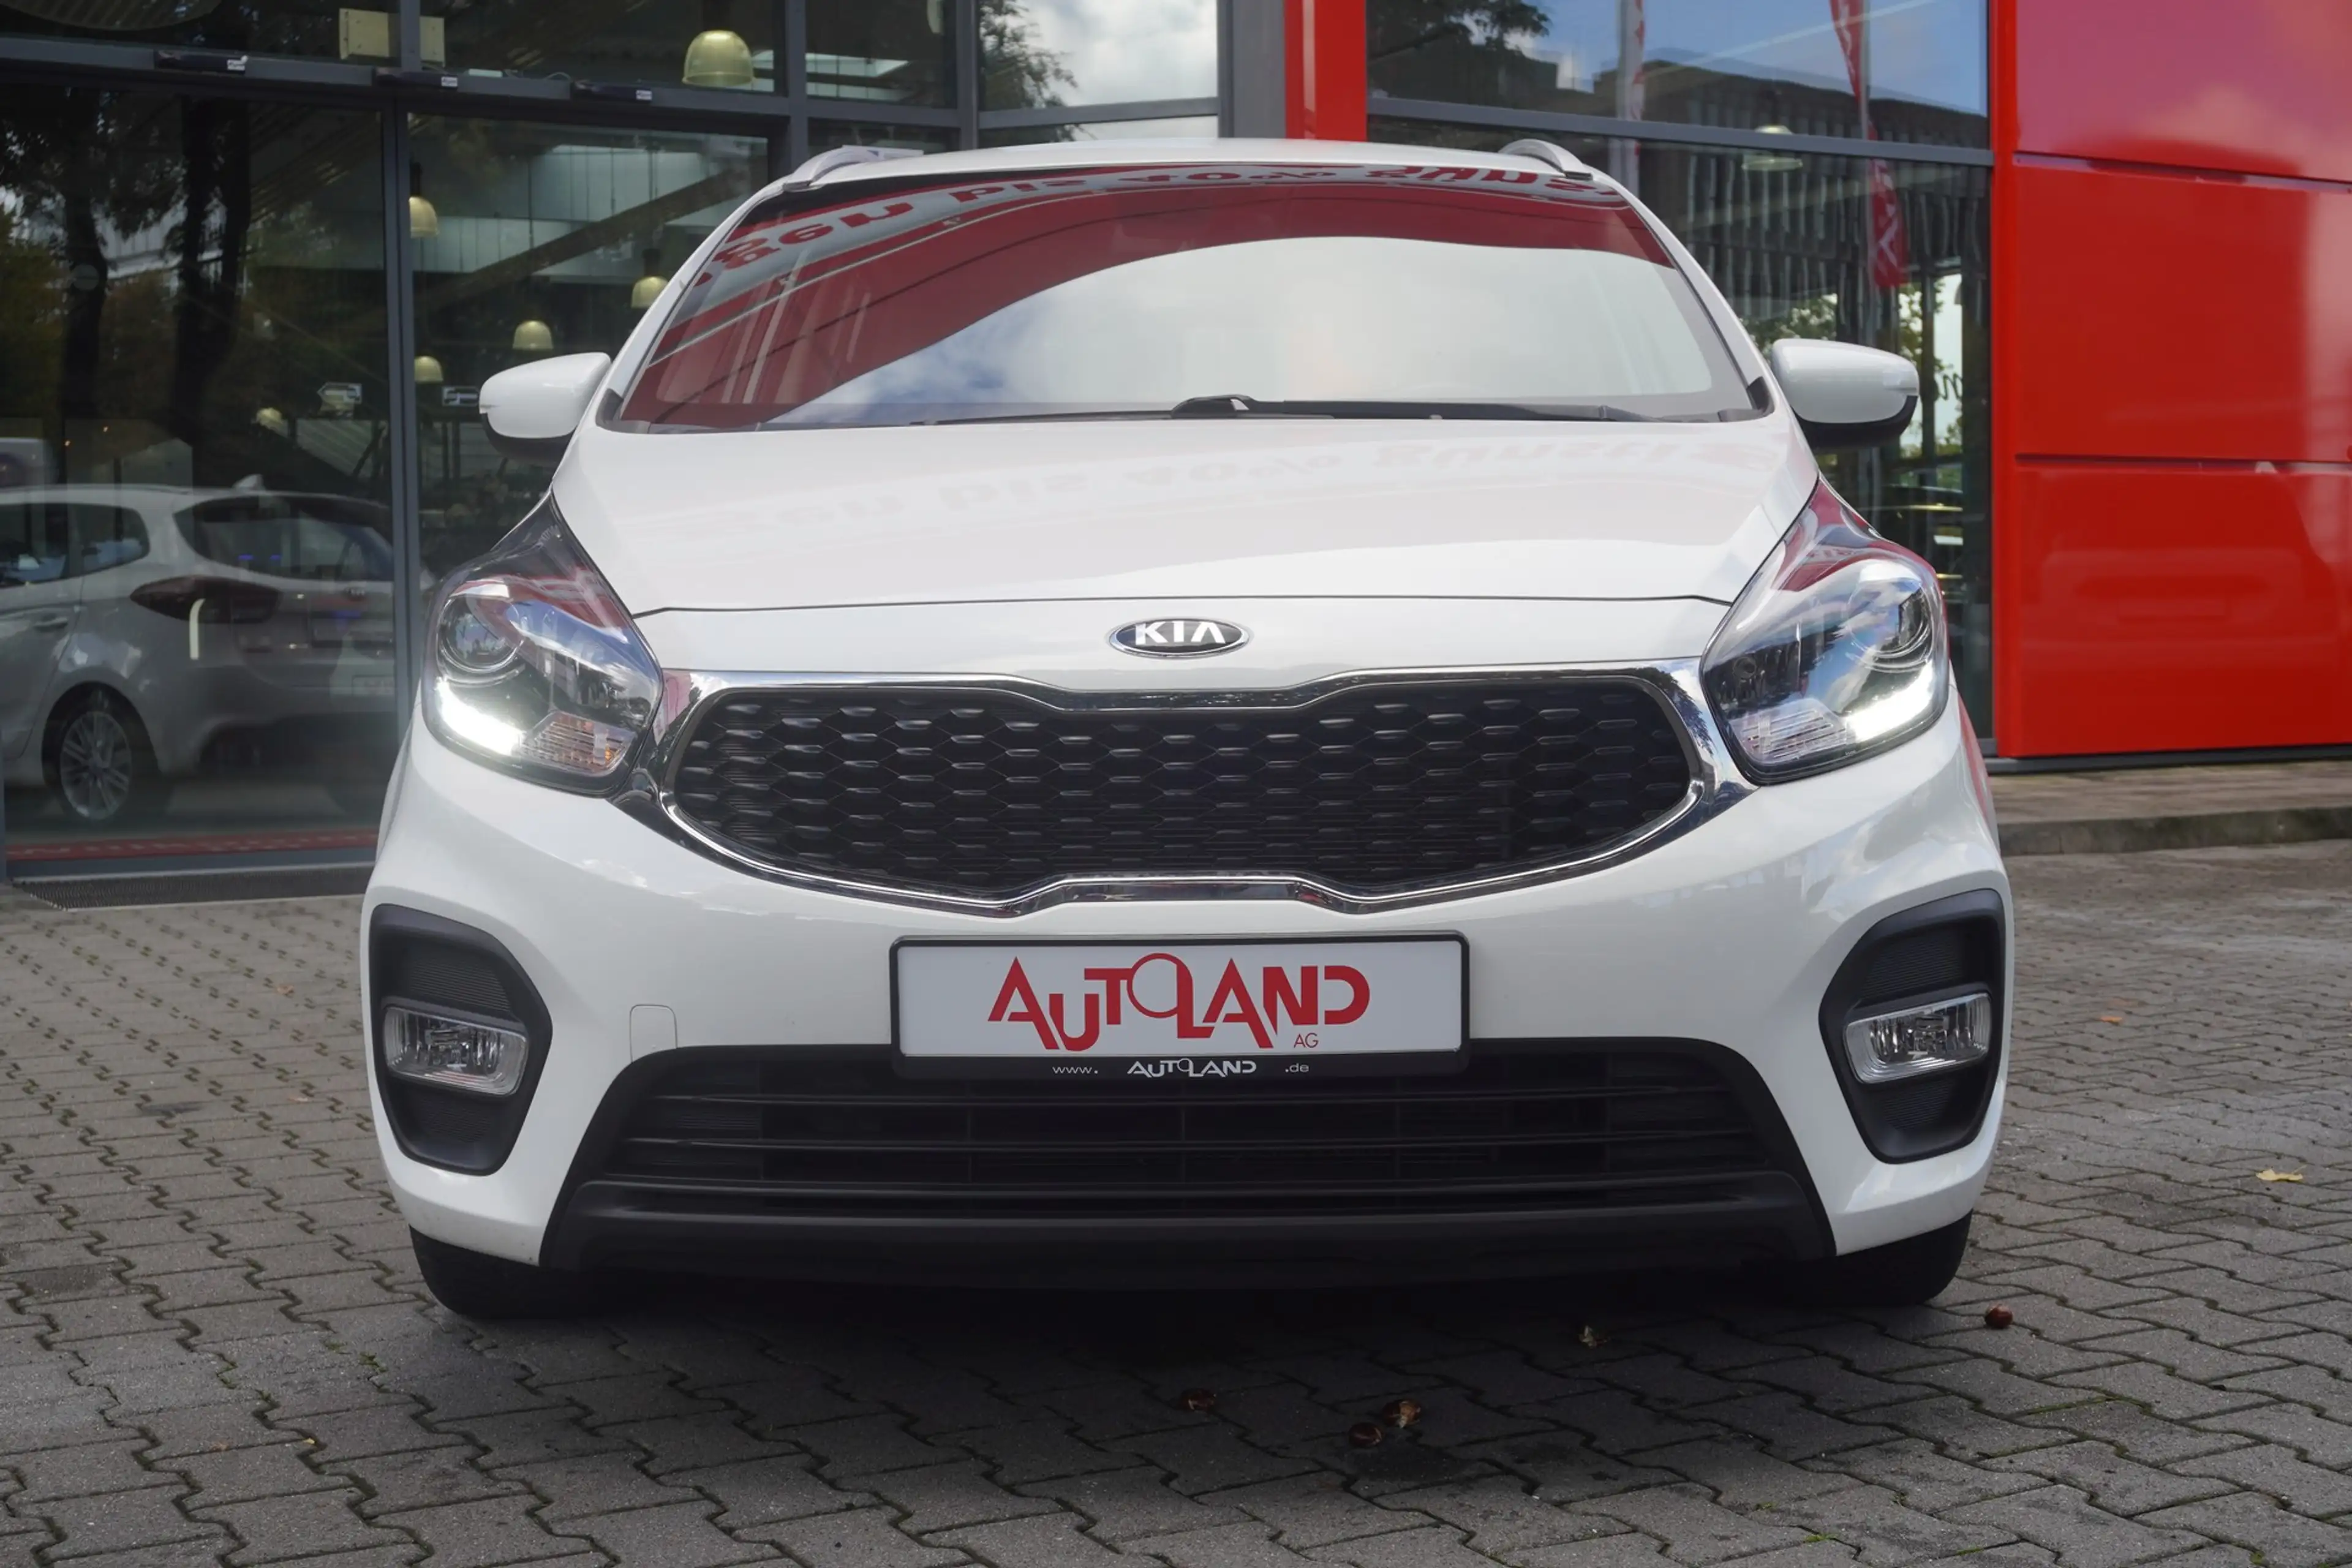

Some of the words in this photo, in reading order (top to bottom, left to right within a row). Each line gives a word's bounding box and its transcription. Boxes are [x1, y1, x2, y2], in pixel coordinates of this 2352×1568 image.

[1135, 620, 1226, 645] KIA
[987, 953, 1371, 1052] AUTOLAND
[1293, 1032, 1319, 1048] AG
[1052, 1065, 1099, 1074] www.
[1126, 1057, 1257, 1078] AUTOLAND
[1285, 1062, 1310, 1073] .de
